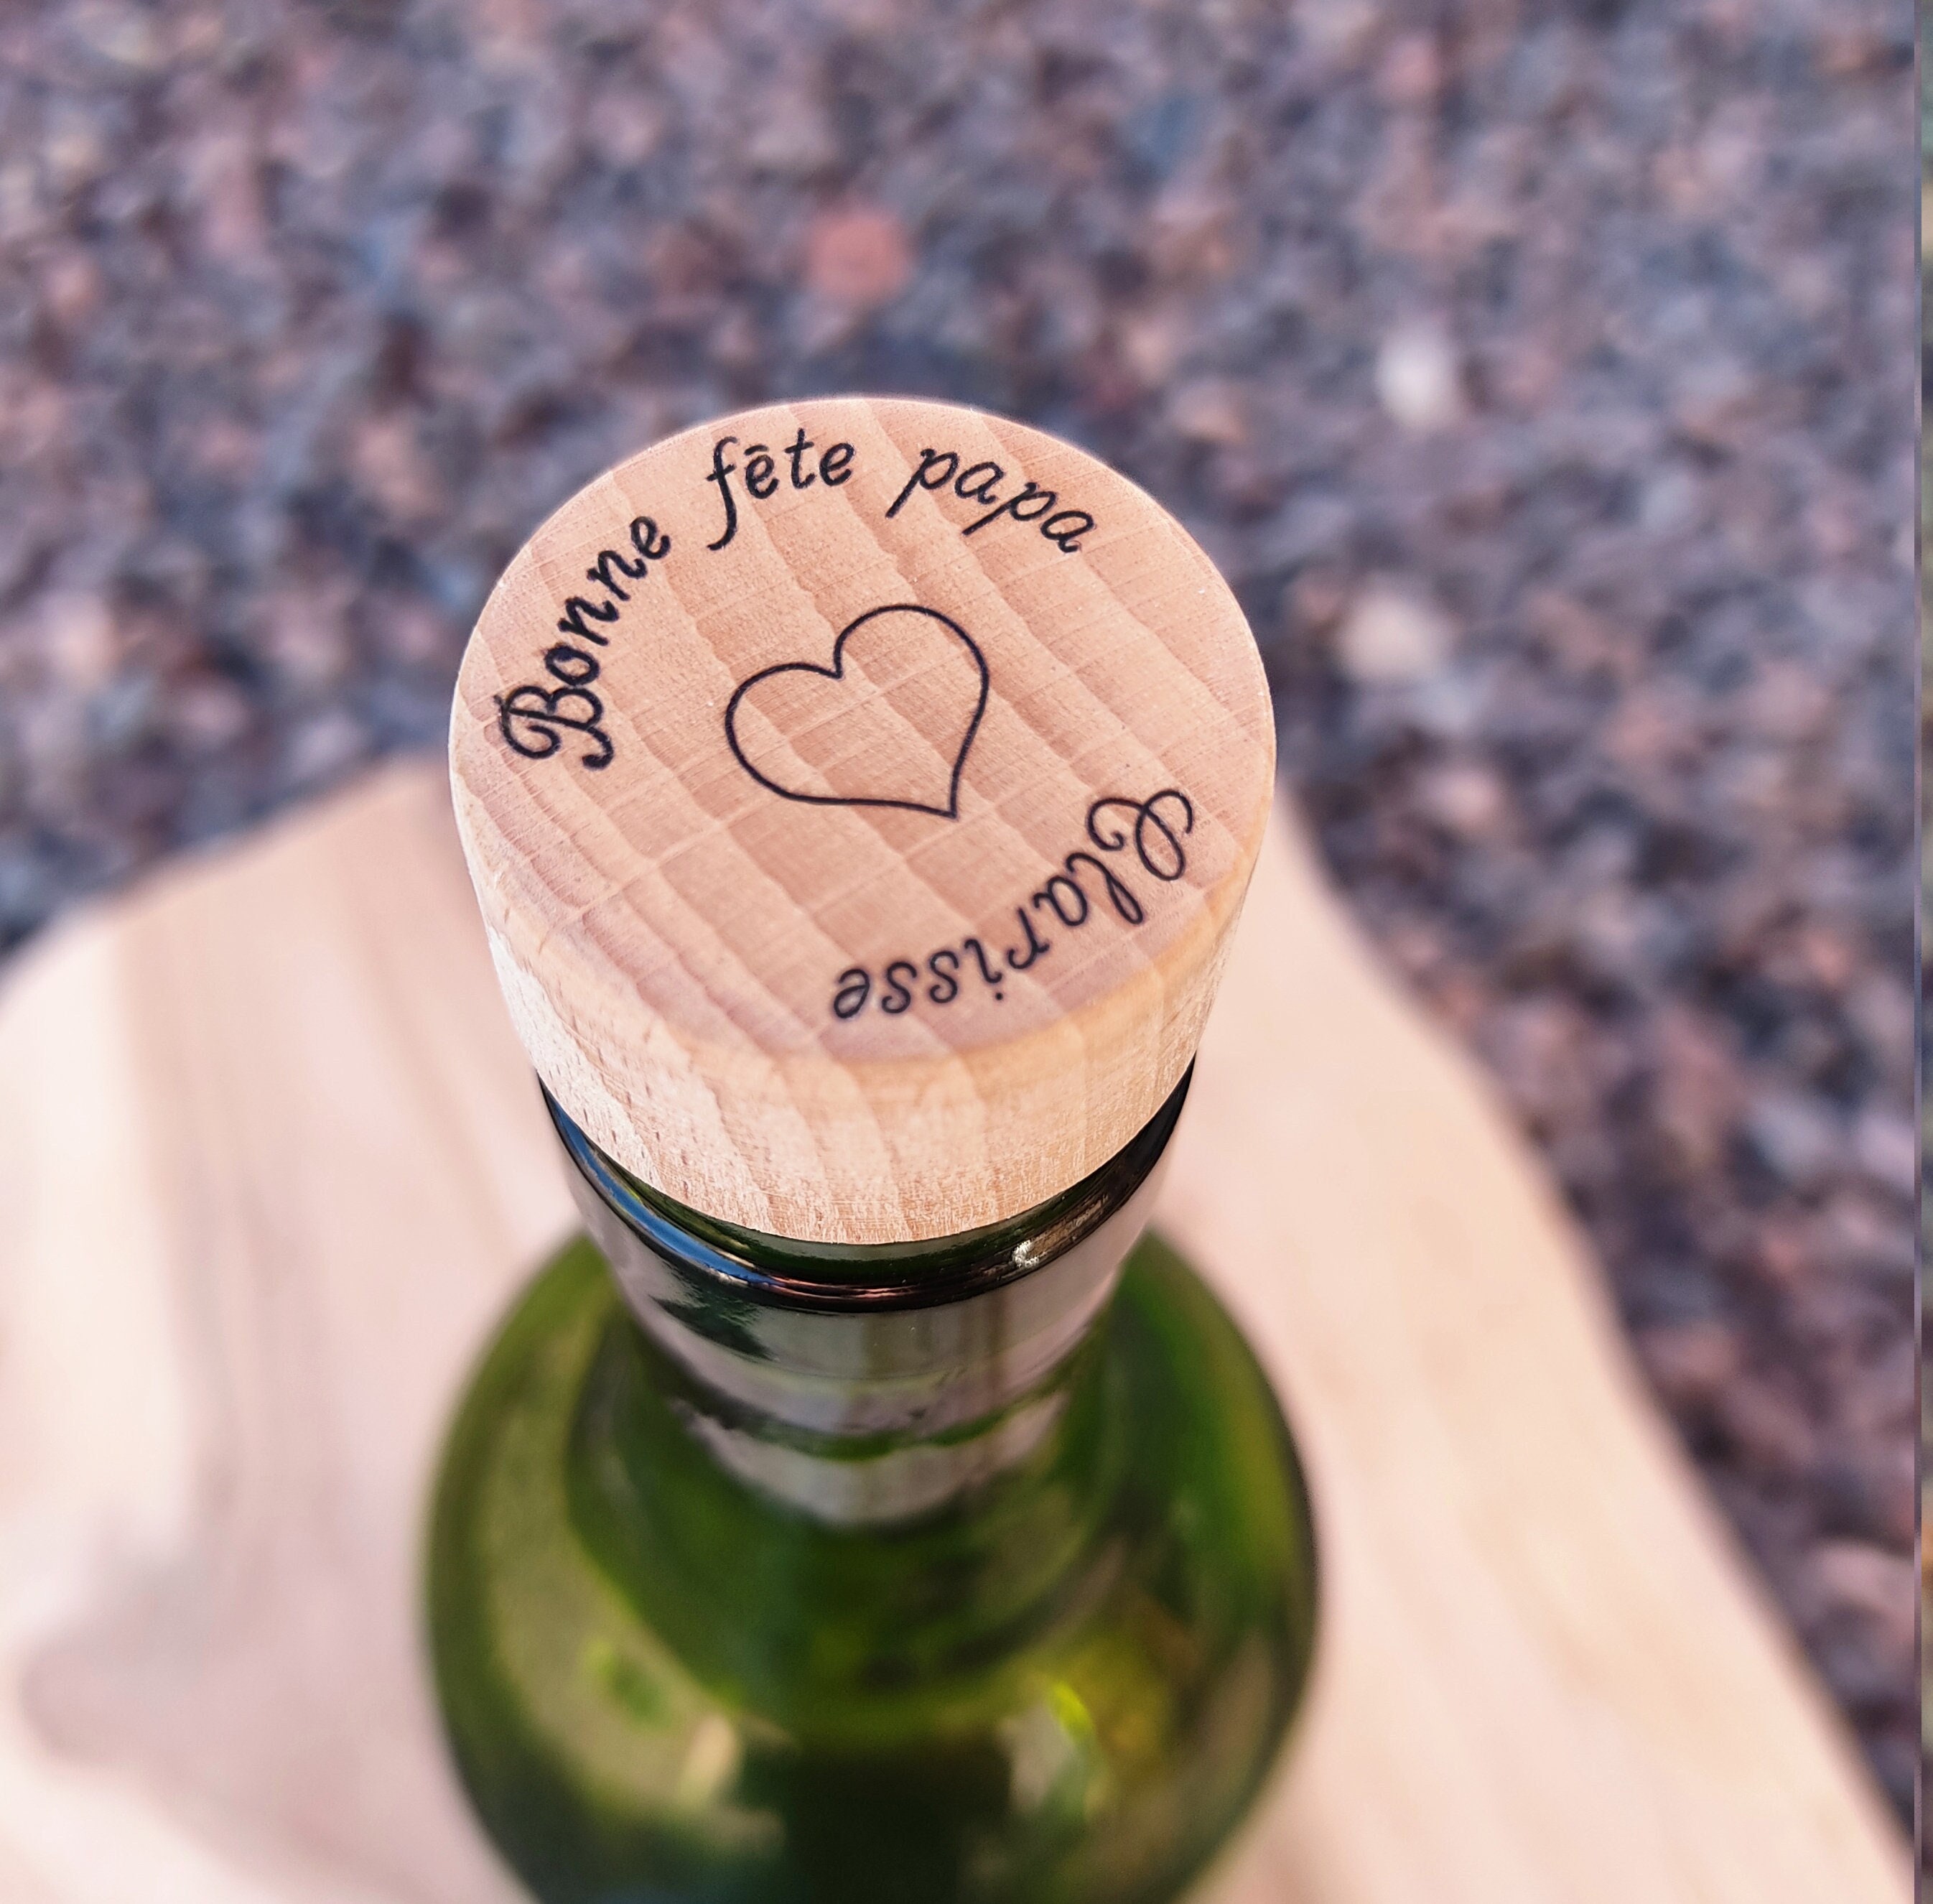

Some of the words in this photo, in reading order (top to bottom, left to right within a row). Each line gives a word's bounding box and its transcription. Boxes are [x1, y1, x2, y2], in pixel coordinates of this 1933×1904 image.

[493, 515, 671, 771] Bonne
[885, 447, 1096, 554] papa
[832, 788, 1196, 1021] Clarisse
